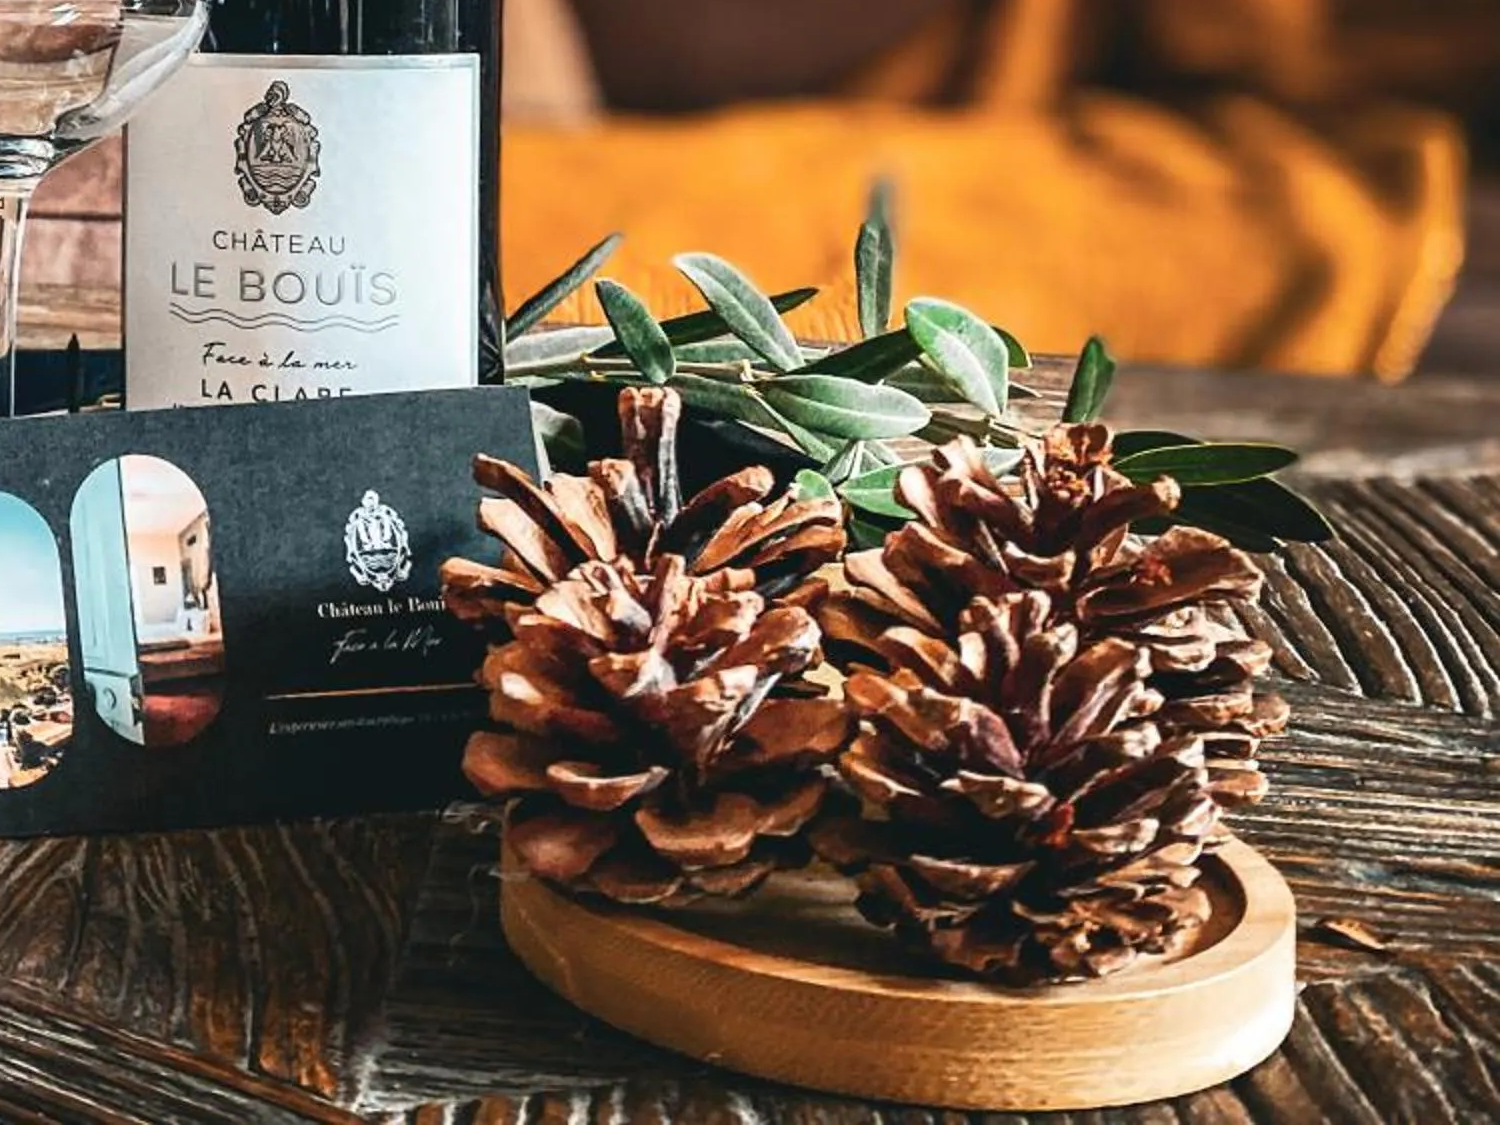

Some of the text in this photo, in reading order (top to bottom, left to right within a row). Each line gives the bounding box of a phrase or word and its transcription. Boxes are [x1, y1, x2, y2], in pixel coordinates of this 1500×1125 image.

[212, 228, 346, 256] CHÂTEAU
[171, 261, 398, 306] LE BOUÏS
[202, 341, 359, 370] Face à la mer
[201, 379, 233, 401] LA
[317, 601, 383, 618] Château
[387, 597, 402, 614] le
